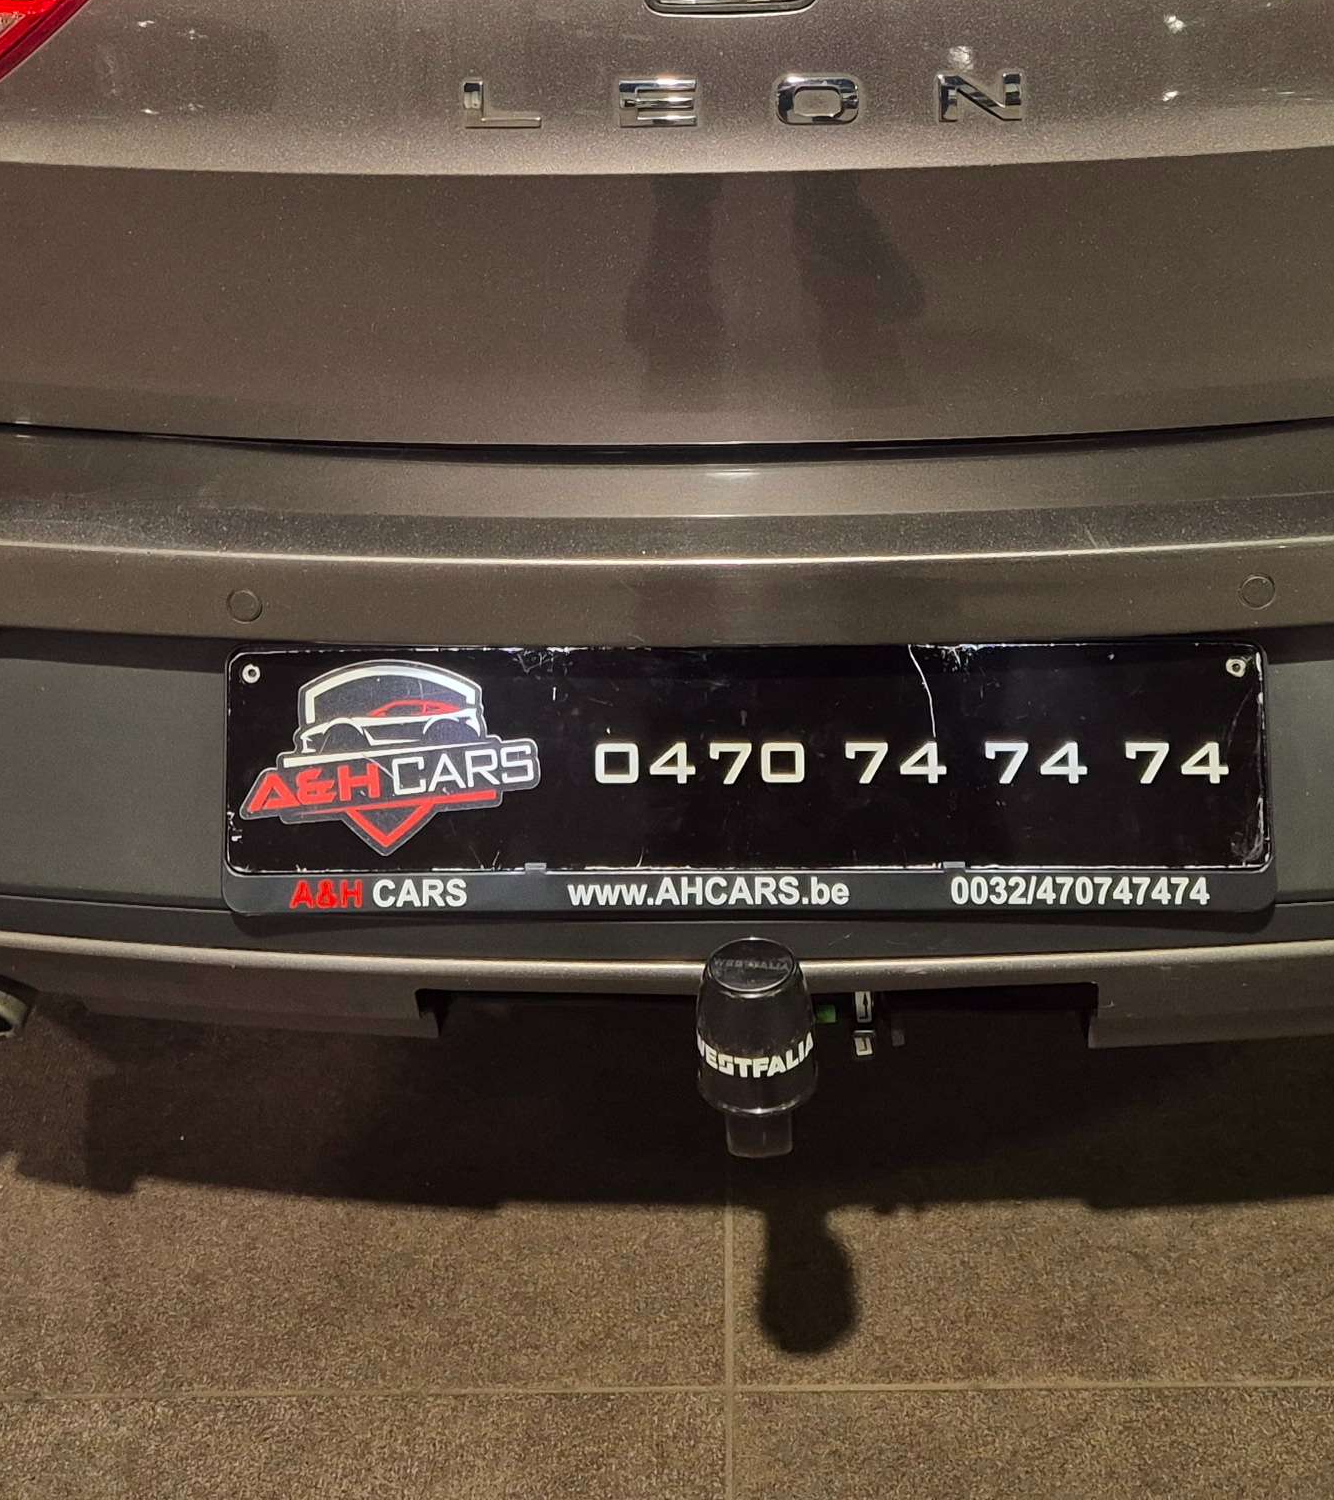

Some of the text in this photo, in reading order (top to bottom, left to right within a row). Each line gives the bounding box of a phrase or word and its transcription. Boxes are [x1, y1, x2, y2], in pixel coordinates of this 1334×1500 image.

[462, 72, 1024, 128] LEON
[249, 744, 532, 814] A&H CARS
[594, 740, 1230, 785] 0470 74 74 74
[288, 876, 469, 911] A&H CARS
[566, 875, 851, 907] www.AHCARS.be
[950, 874, 1212, 906] 0032/470747474
